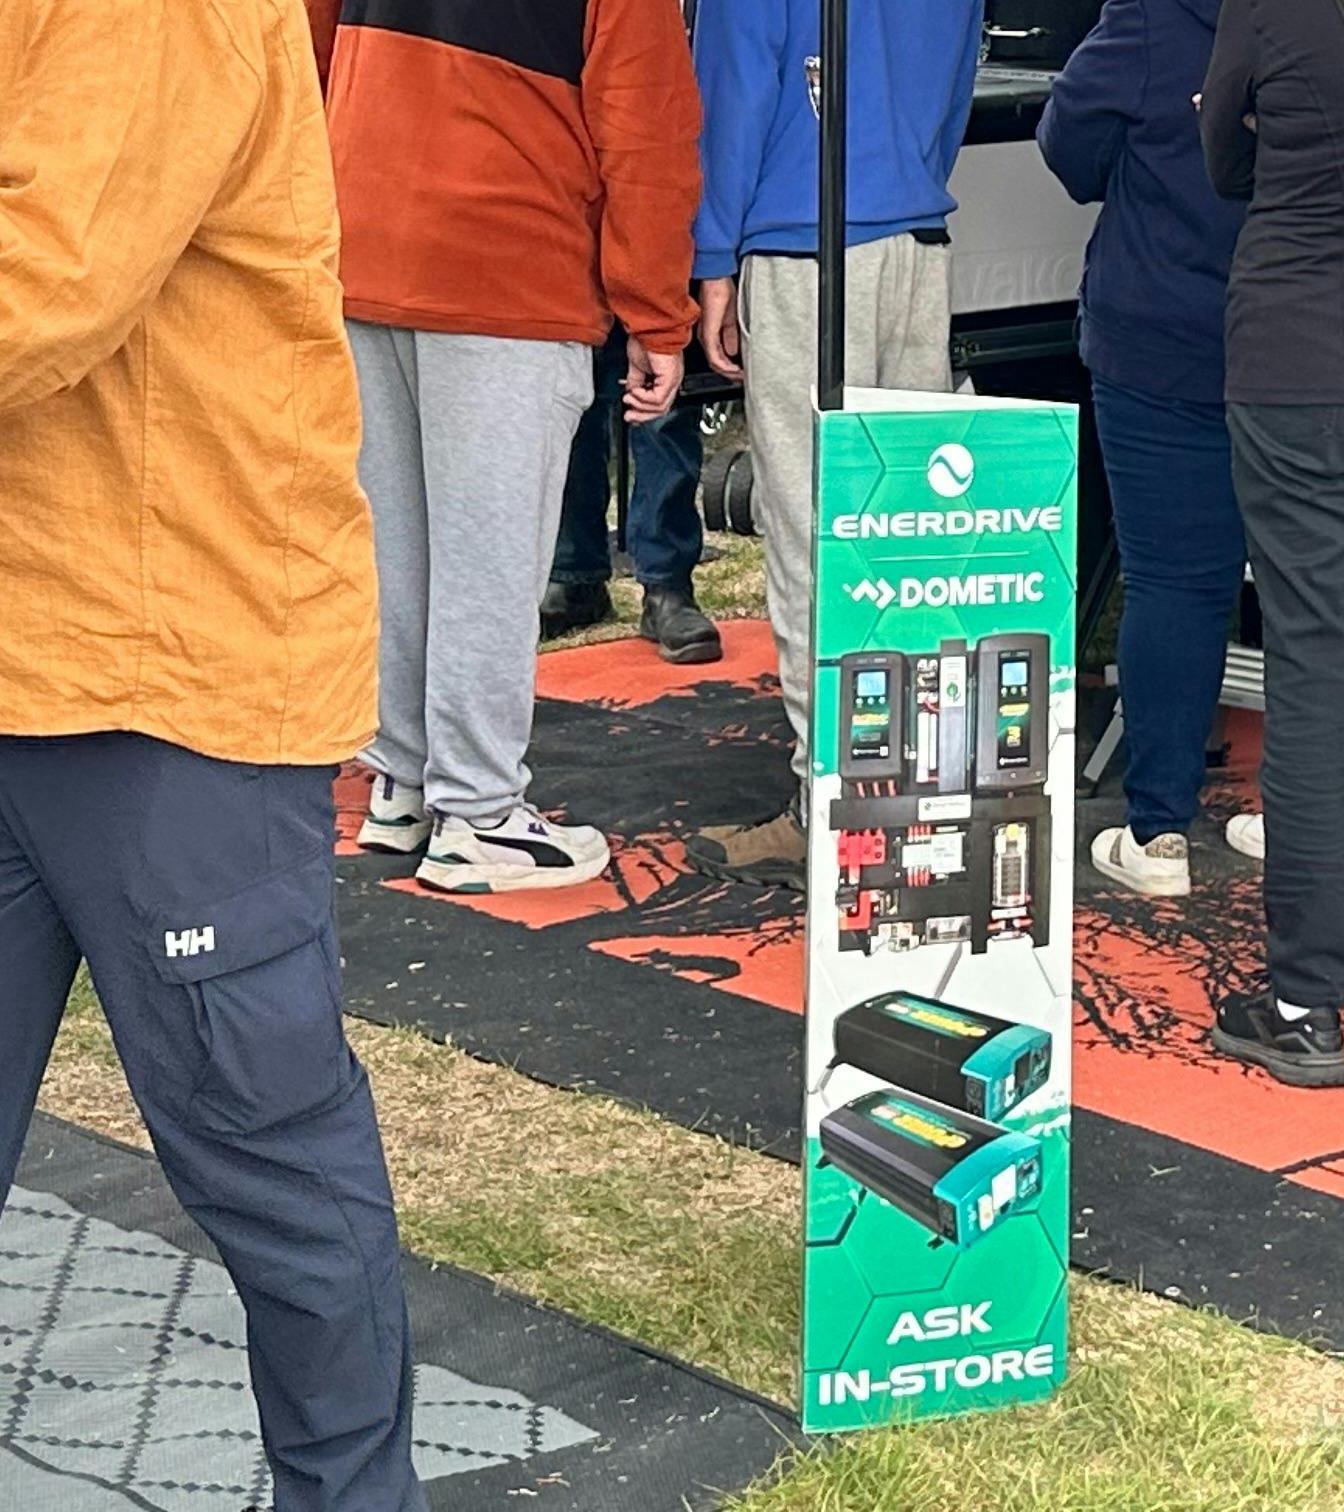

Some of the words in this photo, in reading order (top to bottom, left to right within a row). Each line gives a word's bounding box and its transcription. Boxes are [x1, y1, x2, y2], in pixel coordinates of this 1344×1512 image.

[832, 506, 1063, 539] ENERDRIVE
[900, 571, 1045, 608] DOMETIC
[164, 925, 215, 957] HH
[887, 1300, 993, 1345] ASK
[818, 1343, 1054, 1405] IN-STORE
